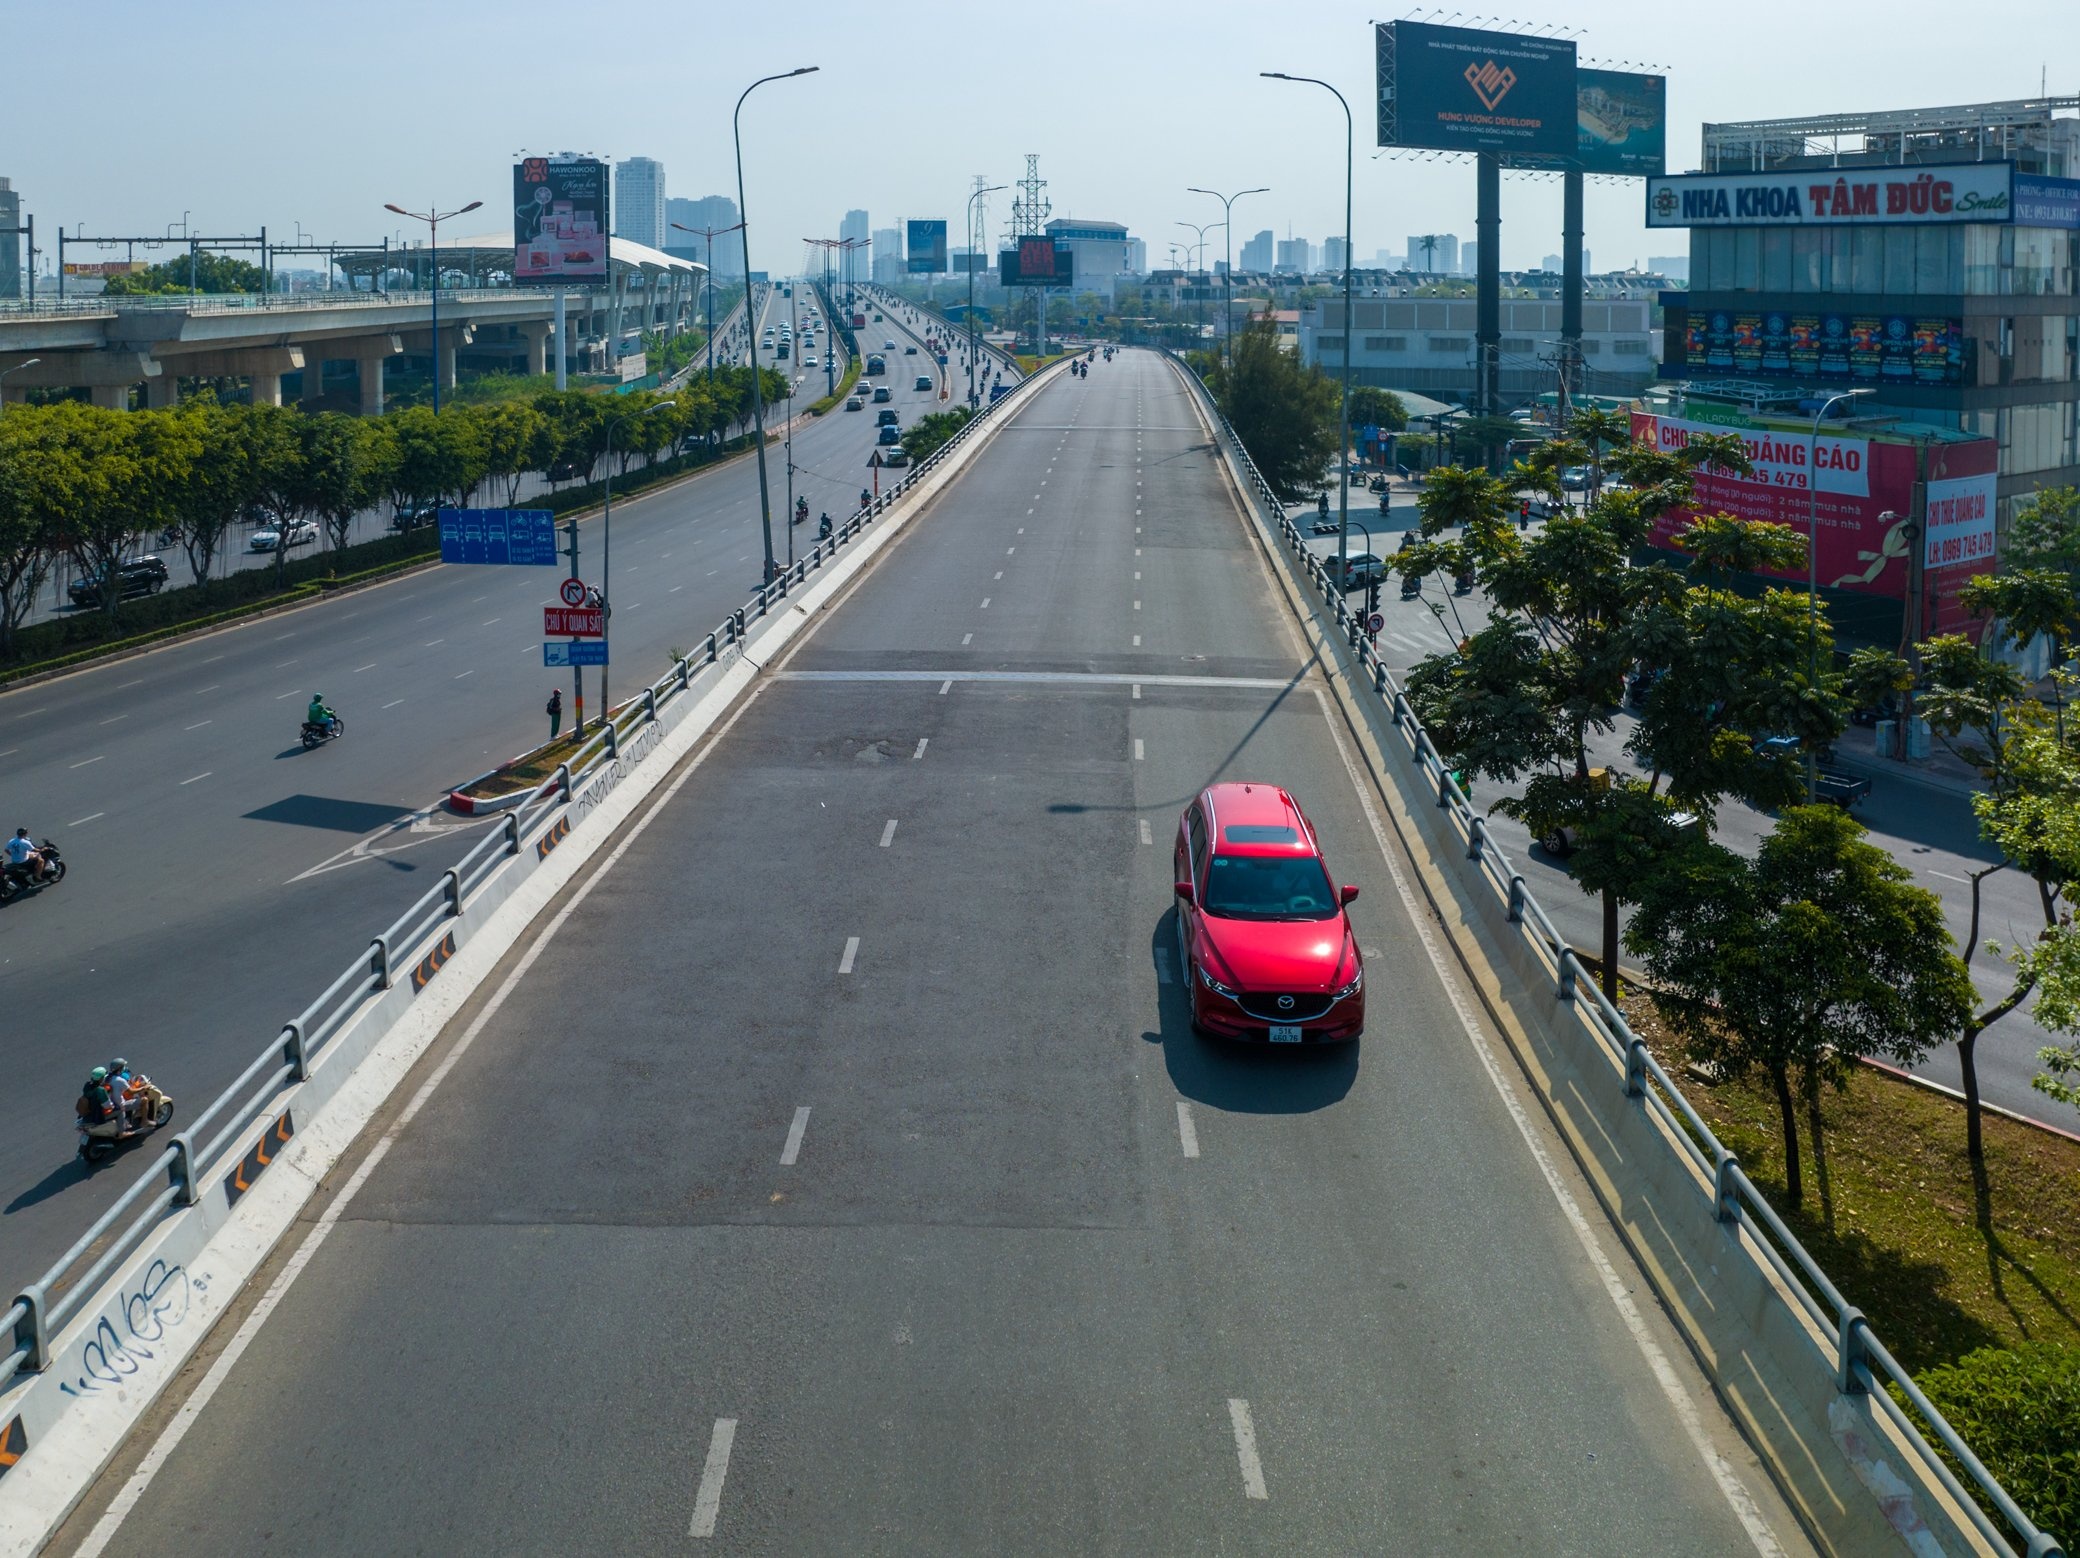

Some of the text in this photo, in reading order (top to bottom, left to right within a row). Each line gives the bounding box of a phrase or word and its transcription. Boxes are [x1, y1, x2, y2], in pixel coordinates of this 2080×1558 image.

[1438, 112, 1542, 128] HƯNG VƯỢNG DEVELOPER
[1682, 173, 2010, 219] NHA KHOA TÂM ĐỨC Smile
[1705, 413, 1753, 427] LADYBUG
[1662, 426, 1689, 448] CHO
[1814, 444, 1861, 472] CÁO
[1774, 471, 1808, 488] 479
[1779, 496, 1786, 505] 2
[1814, 502, 1838, 512] mua
[1928, 489, 1986, 528] CHO THUÊ QUẢNG CÁO
[1779, 511, 1786, 520] 3
[1814, 516, 1838, 527] mua
[1928, 531, 1993, 565] LH: 0969 745 479
[546, 609, 603, 632] CHÚ Ý QUAN SÁT
